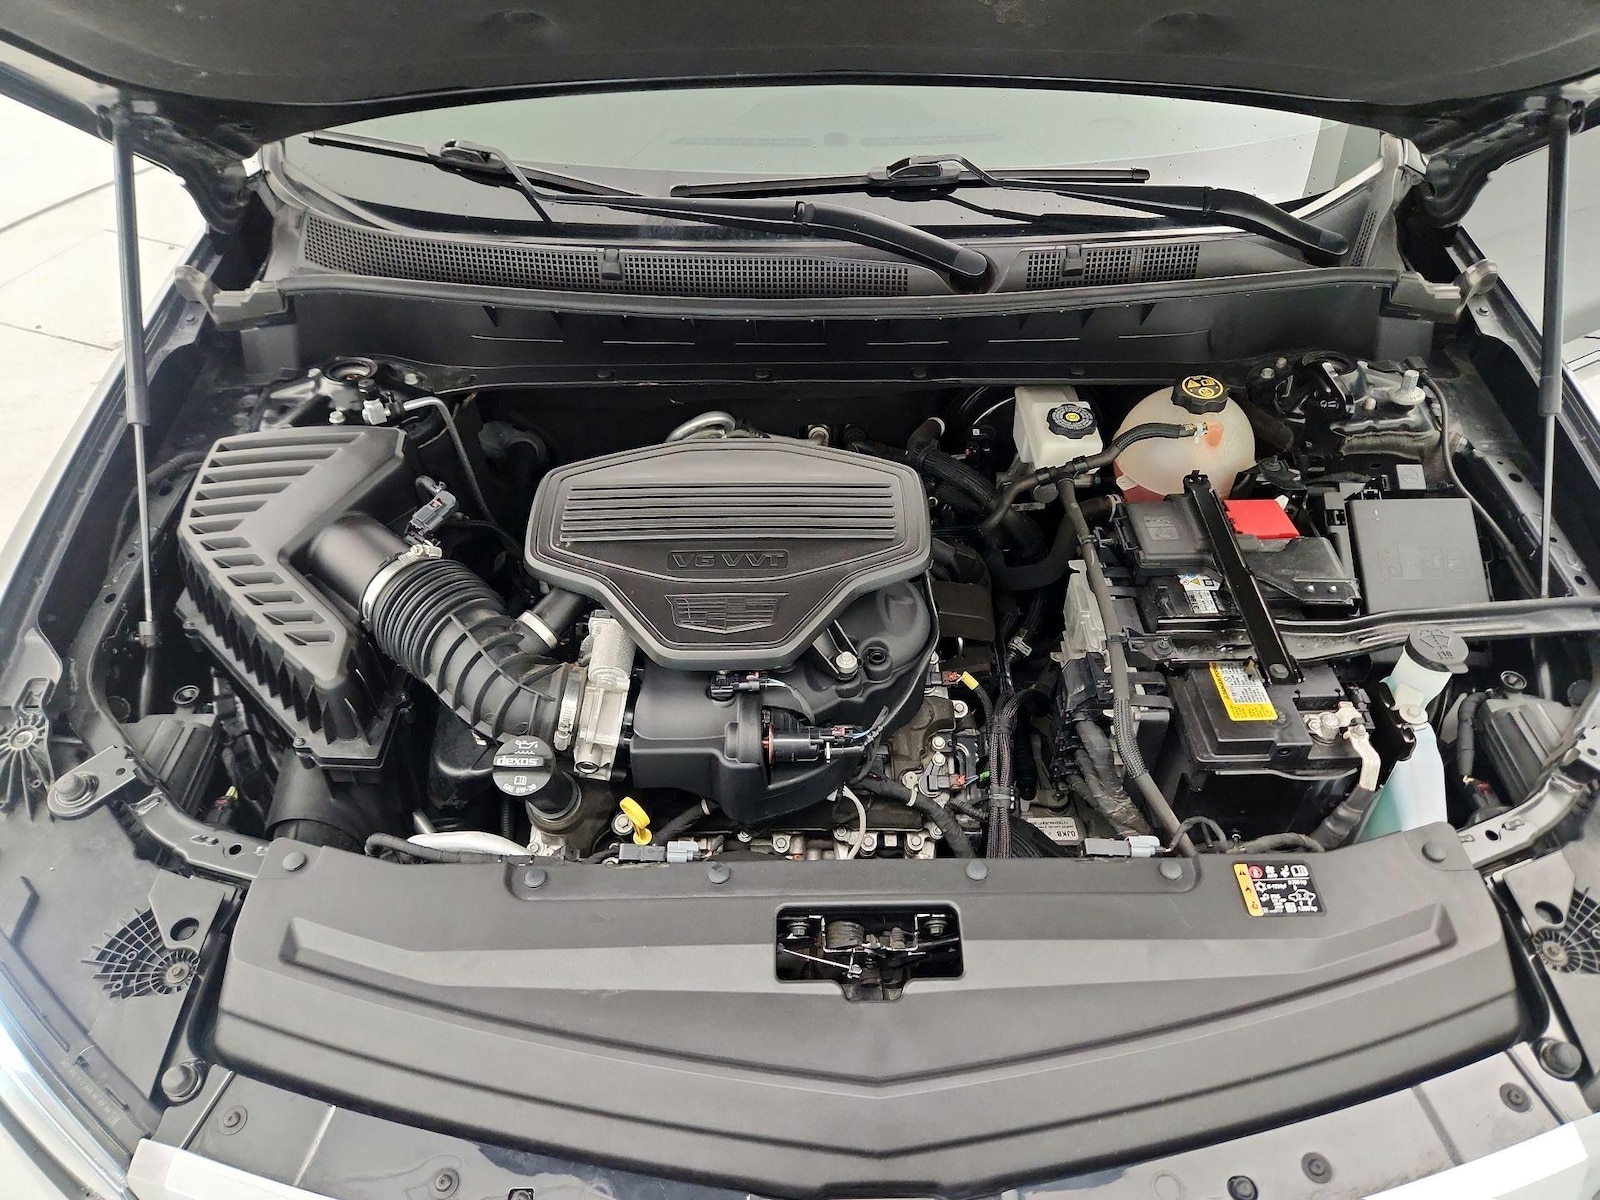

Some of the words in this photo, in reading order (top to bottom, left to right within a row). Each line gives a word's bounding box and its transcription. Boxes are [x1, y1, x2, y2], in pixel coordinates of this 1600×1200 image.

[671, 553, 715, 568] V6
[721, 553, 785, 567] VVT
[496, 756, 539, 766] dexos
